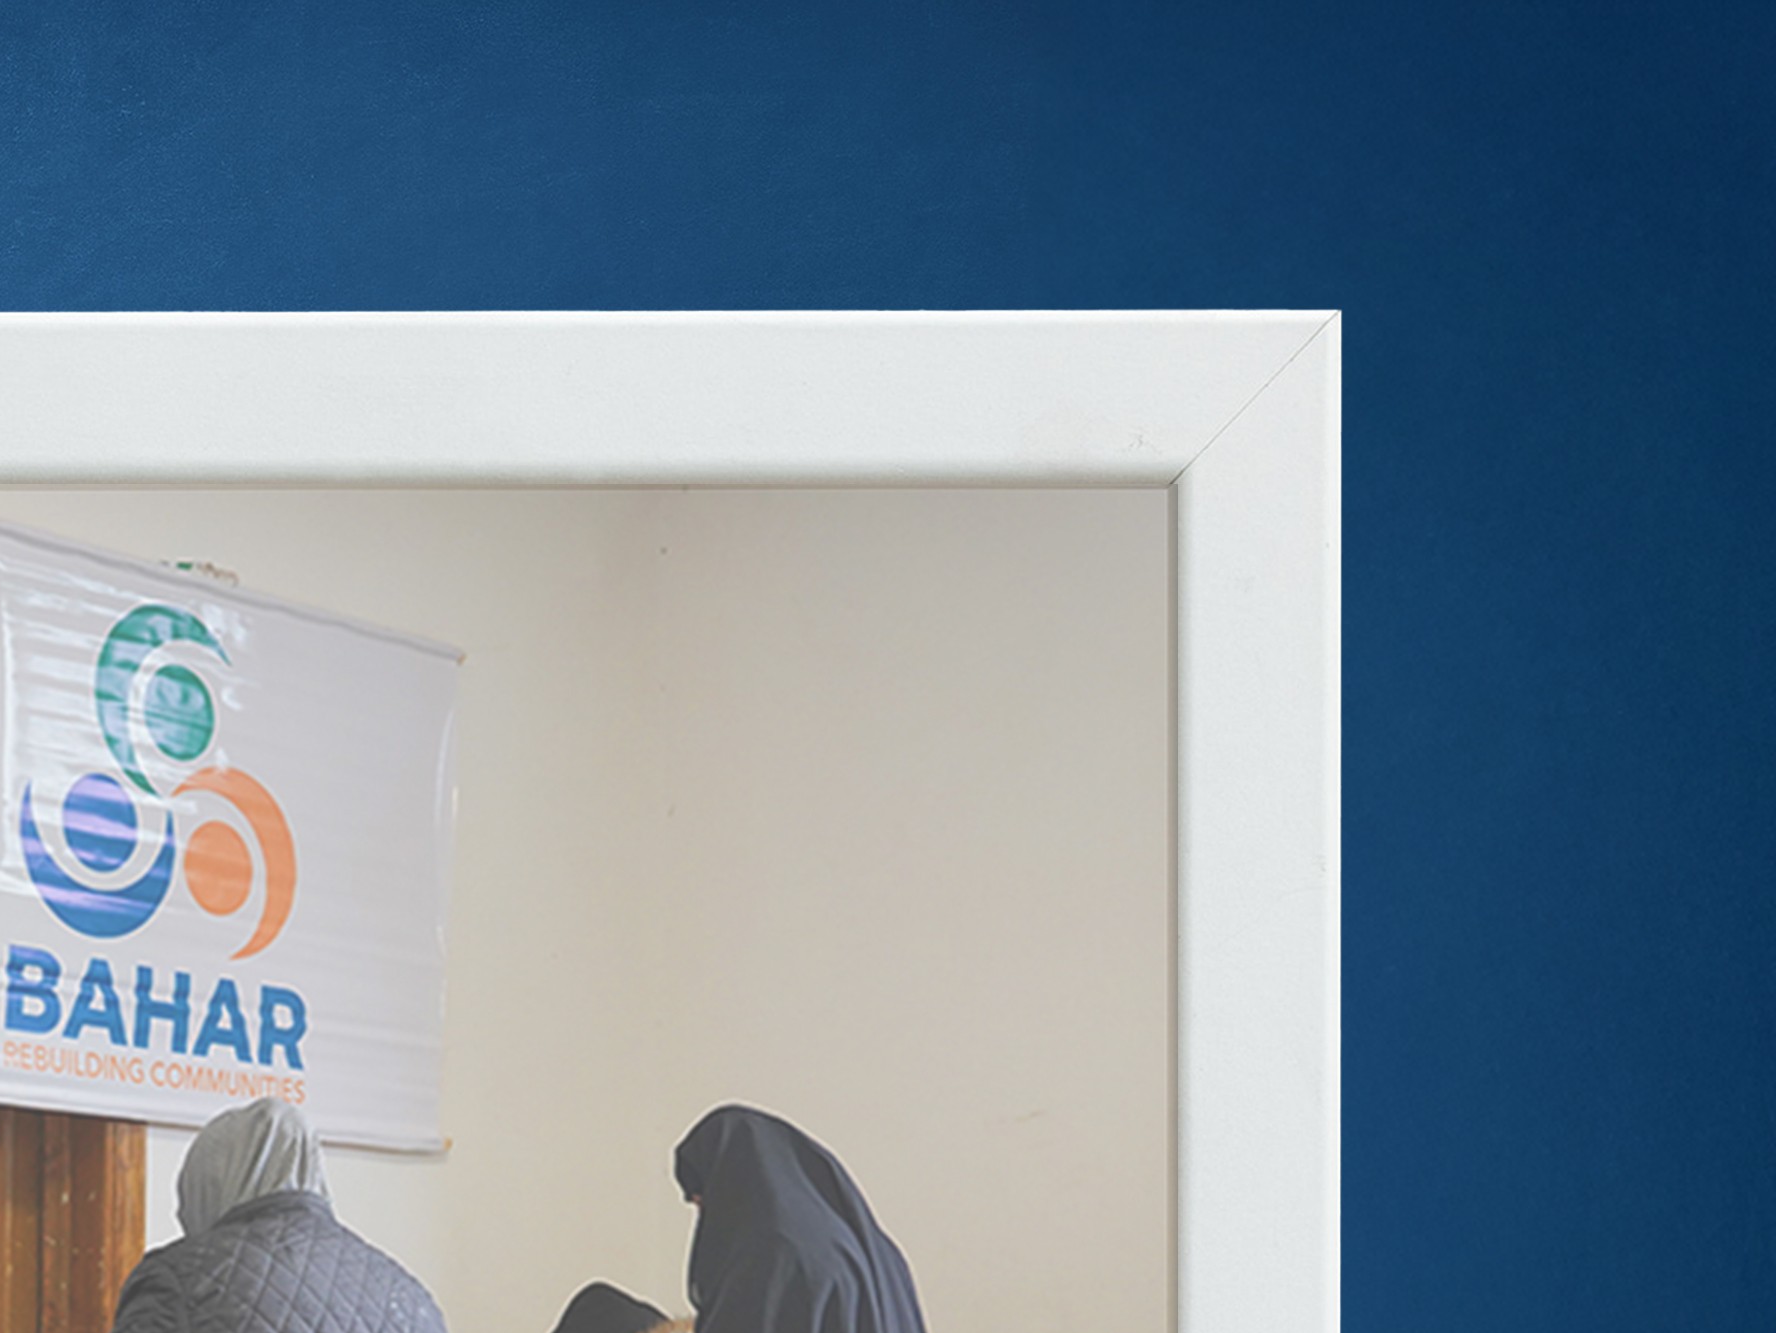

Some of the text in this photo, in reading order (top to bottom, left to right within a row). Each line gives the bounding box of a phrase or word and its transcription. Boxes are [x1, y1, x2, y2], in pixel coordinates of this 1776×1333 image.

[4, 944, 307, 1070] BAHAR
[3, 1041, 306, 1104] REBUILDING COMMUNITIES
